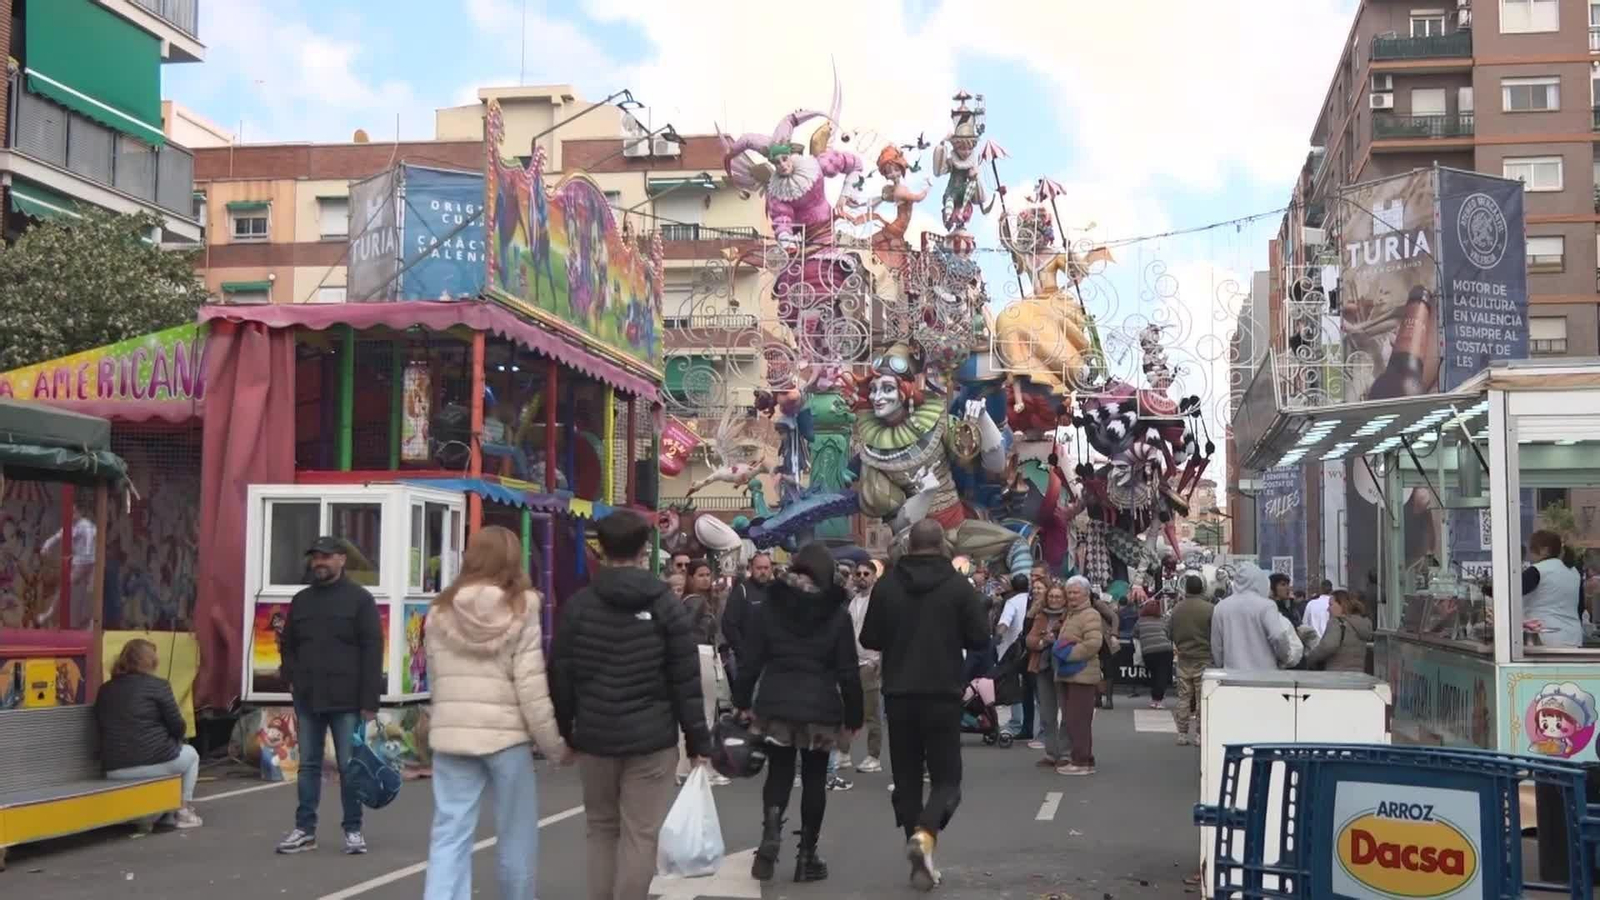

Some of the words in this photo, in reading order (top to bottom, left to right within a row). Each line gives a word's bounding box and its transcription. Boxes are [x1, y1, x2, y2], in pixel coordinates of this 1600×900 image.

[431, 200, 484, 214] ORIG
[352, 226, 395, 264] TURIA
[1453, 280, 1490, 295] MOTOR
[1492, 284, 1507, 296] DE
[1453, 294, 1468, 306] LA
[1469, 296, 1517, 311] CULTURA
[1453, 310, 1468, 322] EN
[1470, 311, 1523, 327] VALENCIA
[1460, 325, 1502, 340] SEMPRE
[1504, 330, 1519, 341] AL
[1456, 341, 1494, 354] COSTAT
[1496, 344, 1512, 356] DE
[1457, 355, 1474, 367] LES
[665, 446, 677, 459] 2
[1265, 489, 1300, 517] FALLES
[1376, 801, 1434, 821] ARROZ
[1350, 829, 1465, 876] Dacsa
